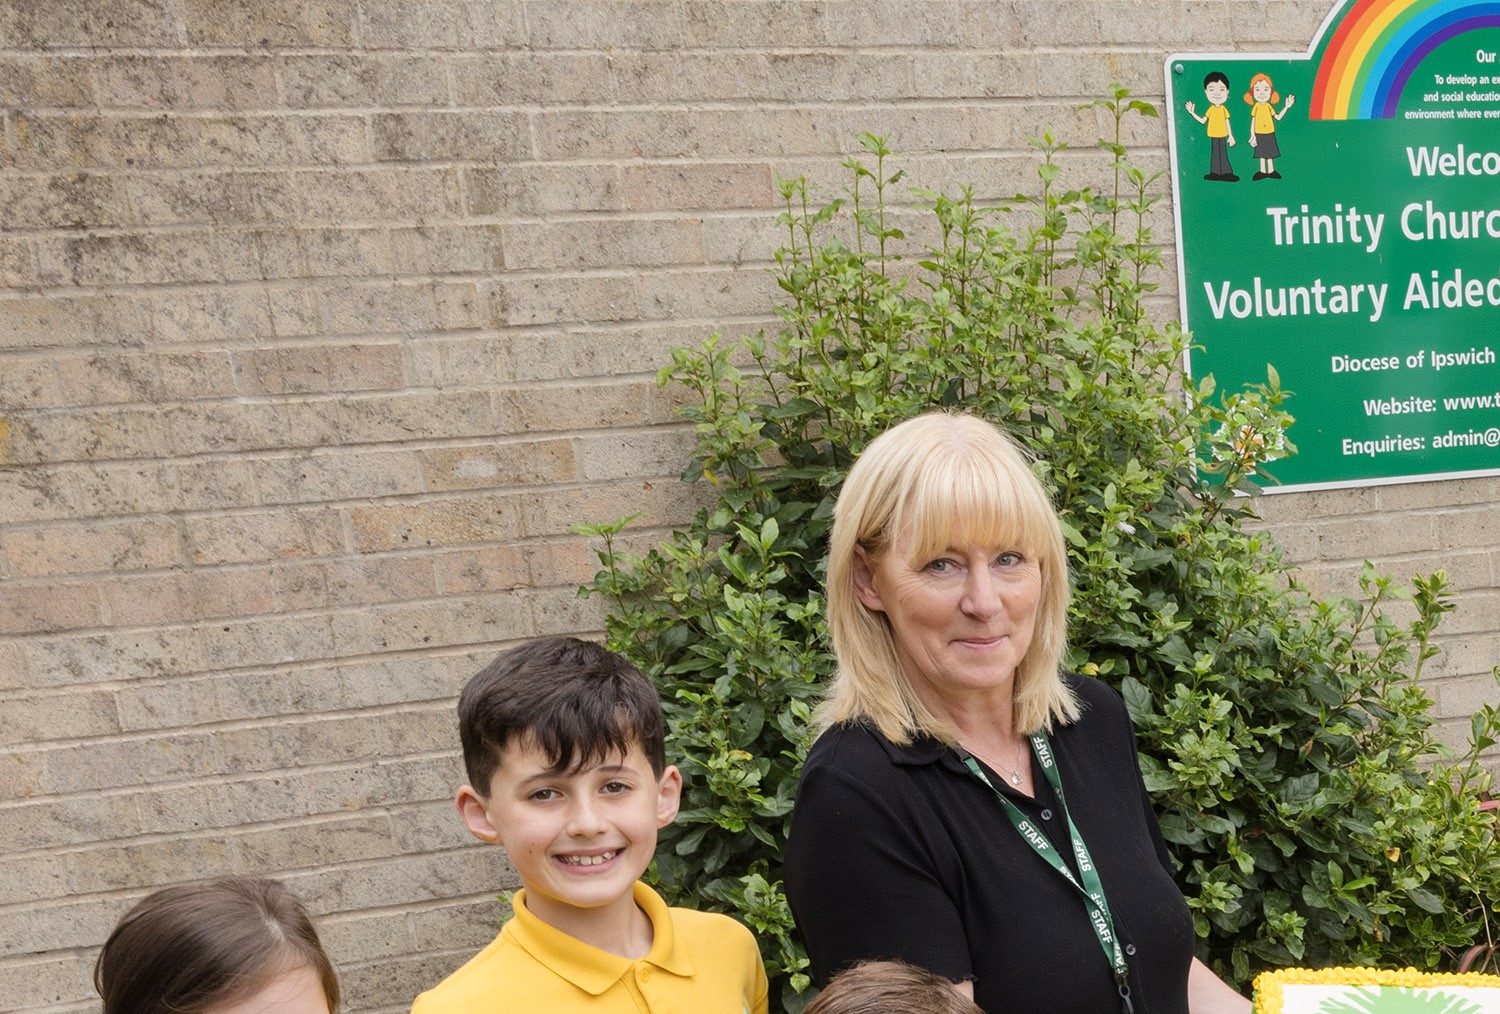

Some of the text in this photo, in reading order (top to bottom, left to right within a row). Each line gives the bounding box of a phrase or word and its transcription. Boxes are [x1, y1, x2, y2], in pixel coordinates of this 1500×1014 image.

[1476, 50, 1496, 63] Our
[1435, 75, 1444, 84] To
[1446, 74, 1477, 86] develop
[1424, 92, 1438, 102] and
[1440, 91, 1464, 102] social
[1405, 109, 1455, 119] environment
[1456, 108, 1482, 118] where
[1266, 204, 1384, 253] Trinity
[1204, 277, 1388, 322] Voluntary
[1332, 355, 1400, 373] Diocese
[1406, 350, 1424, 368] of
[1431, 347, 1495, 371] Ipswich
[1363, 396, 1436, 416] Website:
[1343, 434, 1425, 457] Enquiries:
[1033, 736, 1053, 768] STAFF
[1018, 820, 1049, 850] STAFF
[1073, 839, 1092, 872] STAFF
[1091, 909, 1113, 944] STAFF
